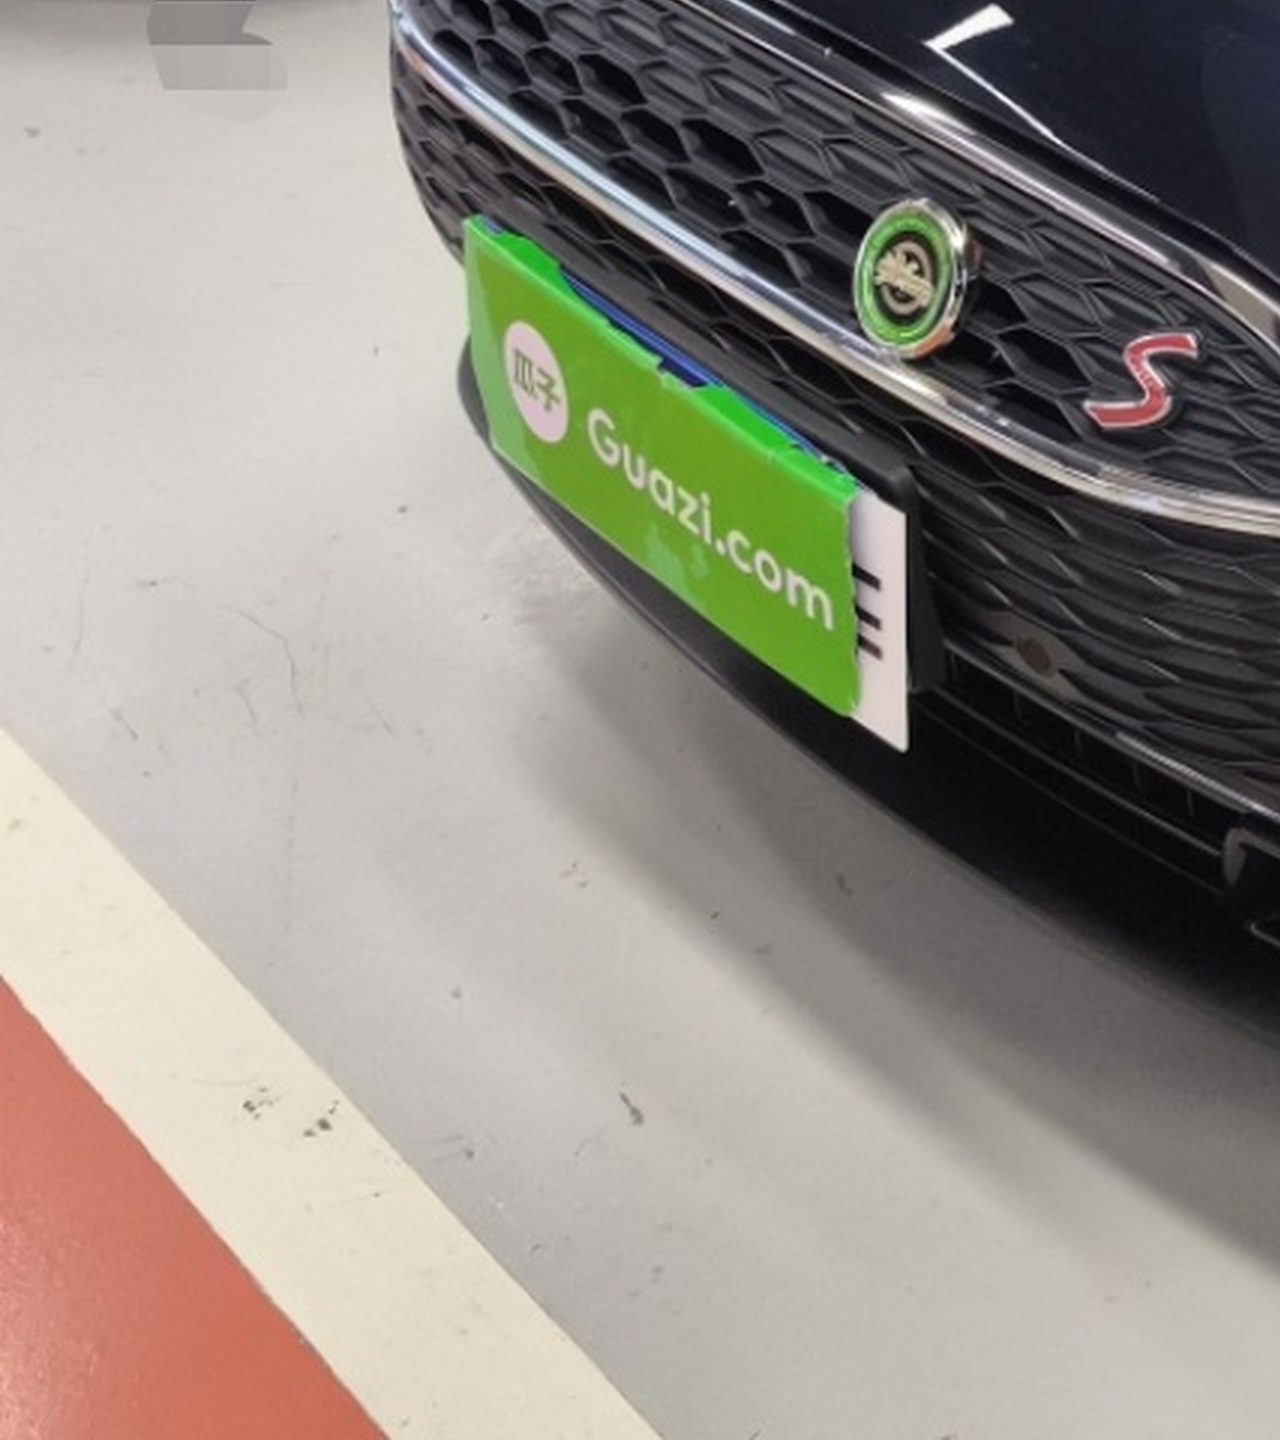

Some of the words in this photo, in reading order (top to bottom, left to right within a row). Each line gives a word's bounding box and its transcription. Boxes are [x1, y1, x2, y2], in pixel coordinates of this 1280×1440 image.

[514, 348, 561, 413] 瓜子
[1082, 332, 1198, 428] S
[587, 408, 834, 631] Guazi.com
